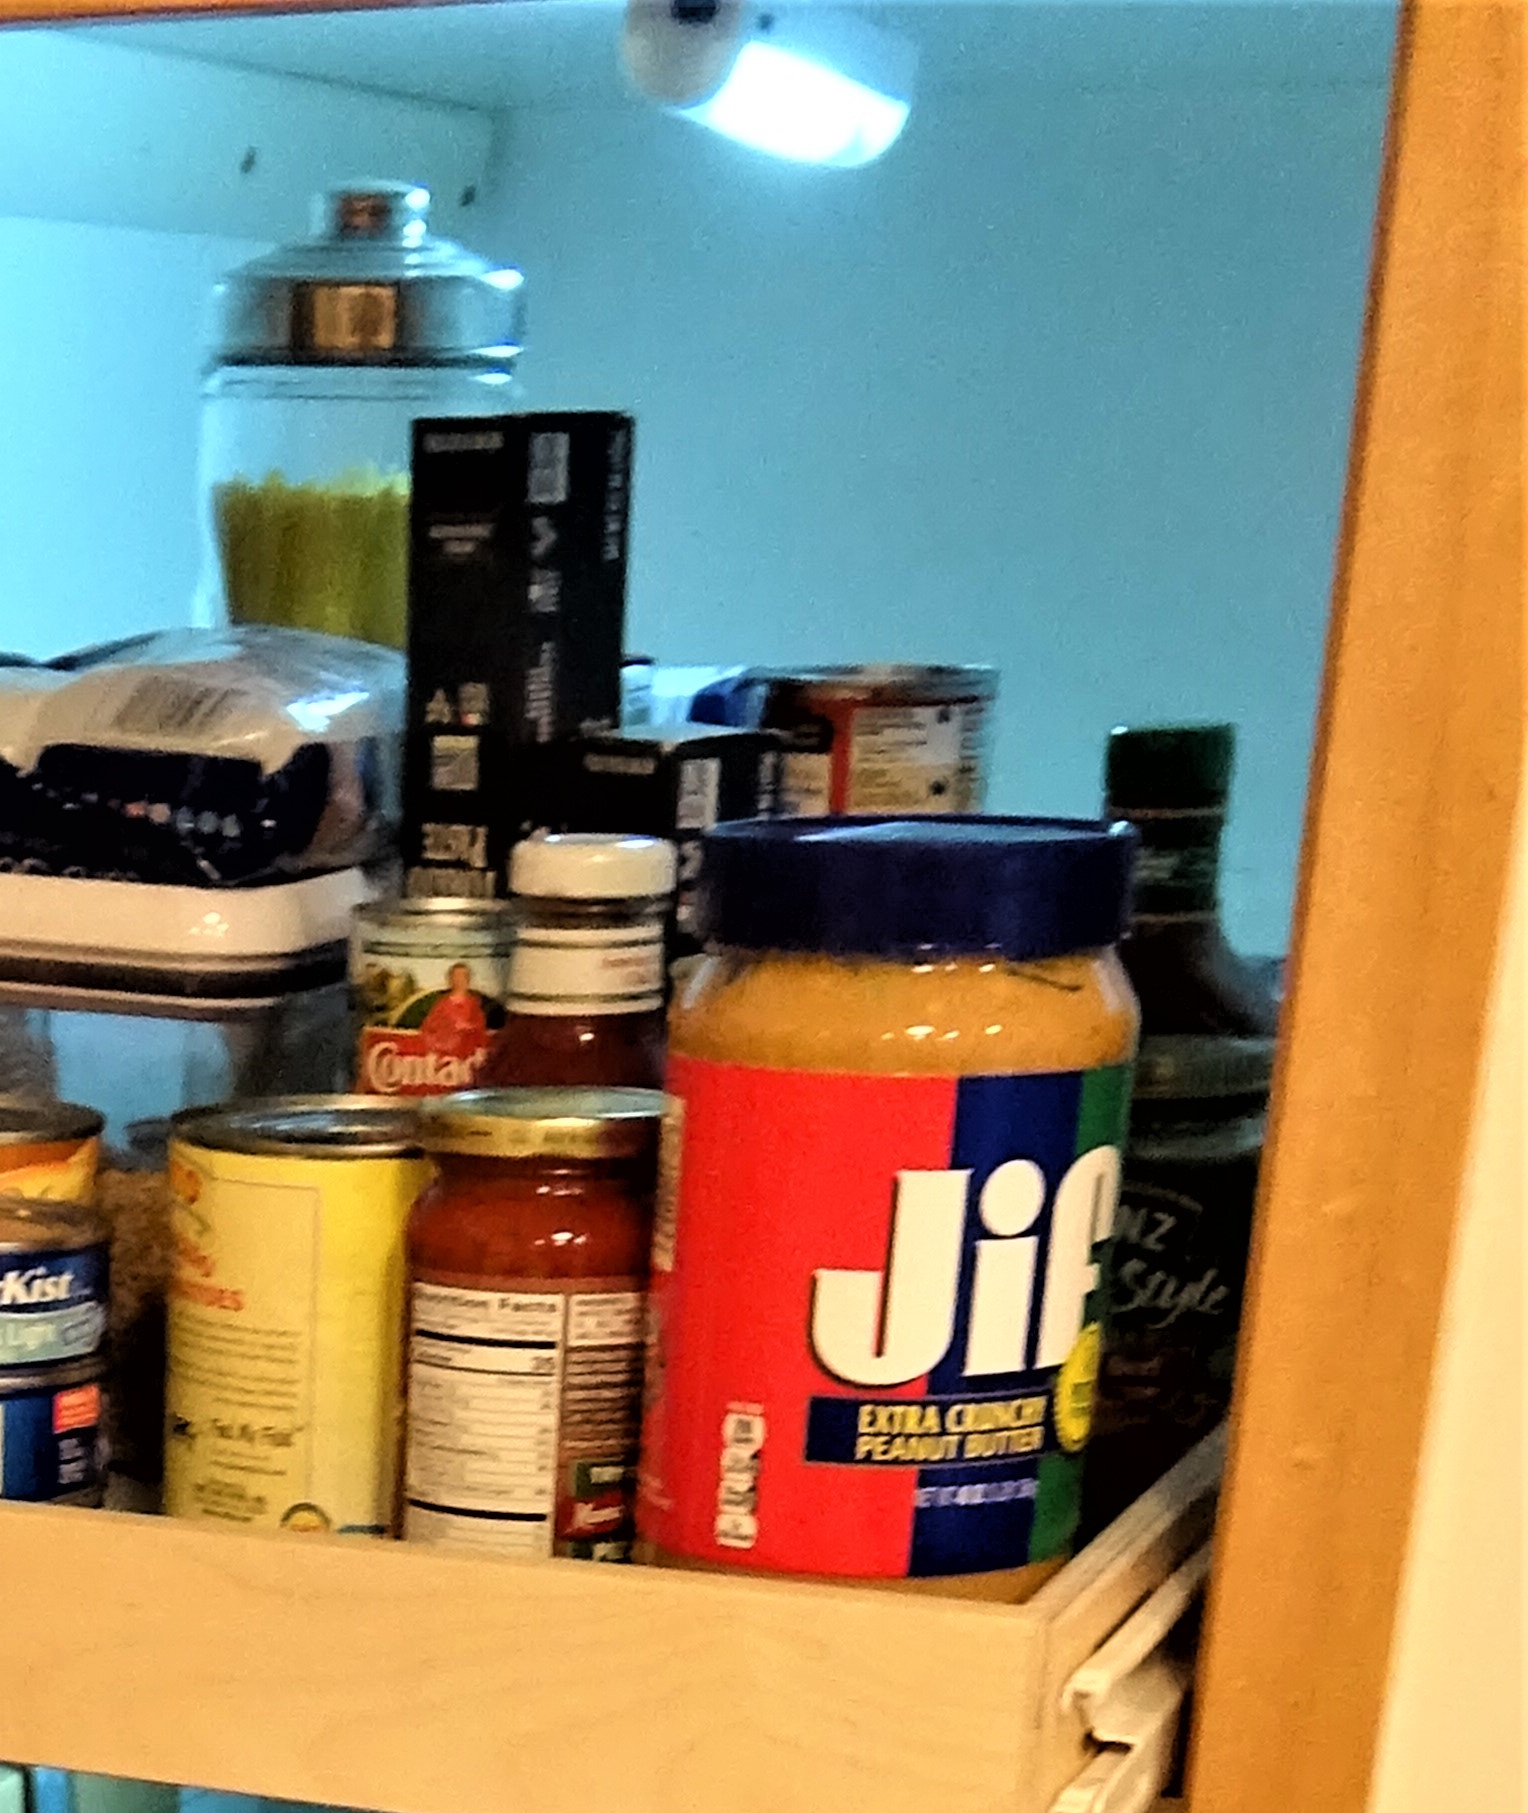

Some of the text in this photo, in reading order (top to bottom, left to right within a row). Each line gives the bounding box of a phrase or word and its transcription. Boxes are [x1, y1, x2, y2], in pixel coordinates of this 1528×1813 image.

[809, 1144, 1121, 1387] Jif
[857, 1402, 942, 1435] EXTRA
[854, 1433, 962, 1462] PEANUT
